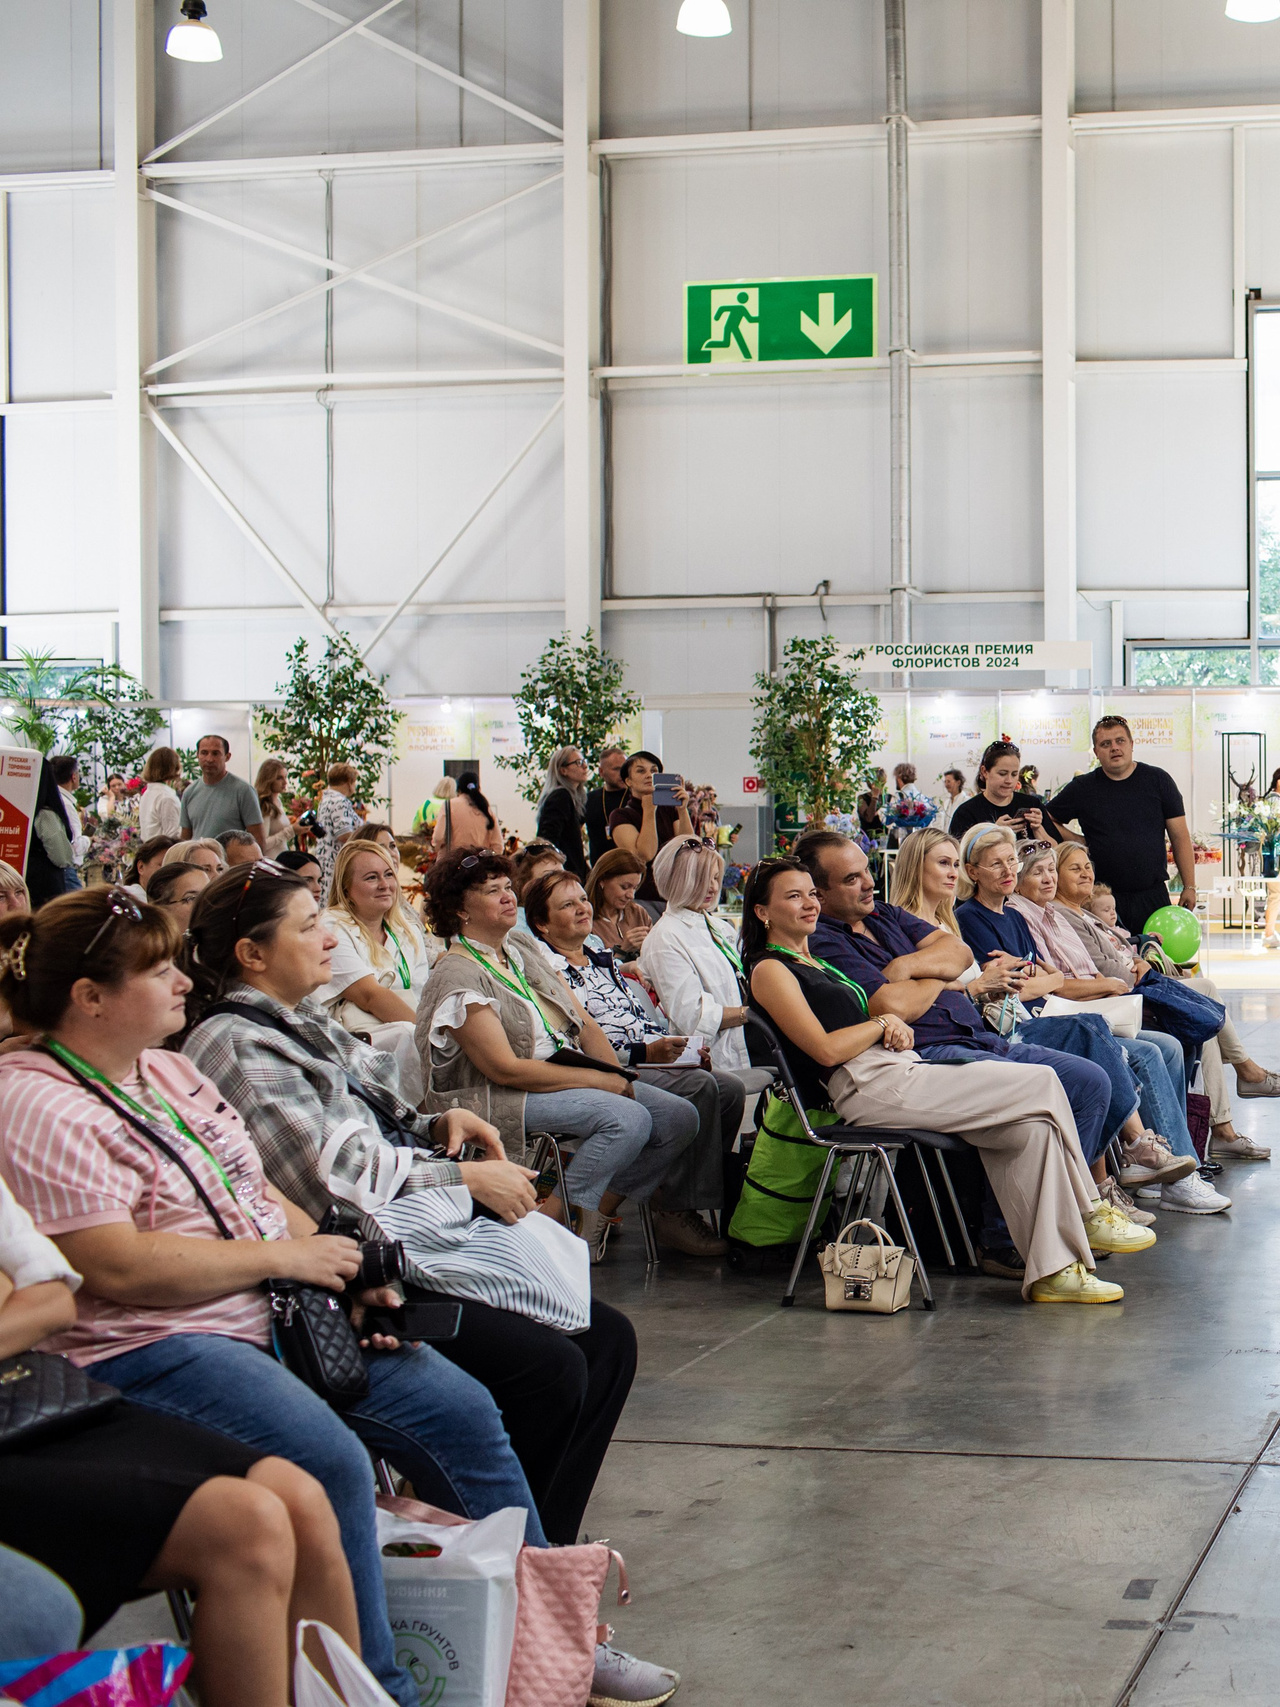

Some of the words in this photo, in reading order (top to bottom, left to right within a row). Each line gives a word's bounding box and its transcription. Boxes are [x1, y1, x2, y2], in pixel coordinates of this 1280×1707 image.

[876, 643, 970, 656] РОССИЙСКАЯ
[975, 644, 1034, 655] ПРЕМИЯ
[892, 657, 981, 668] ФЛОРИСТОВ
[986, 657, 1020, 668] 2024
[0, 825, 20, 835] ННЫЙ
[412, 1620, 460, 1671] ГРУНТОВ
